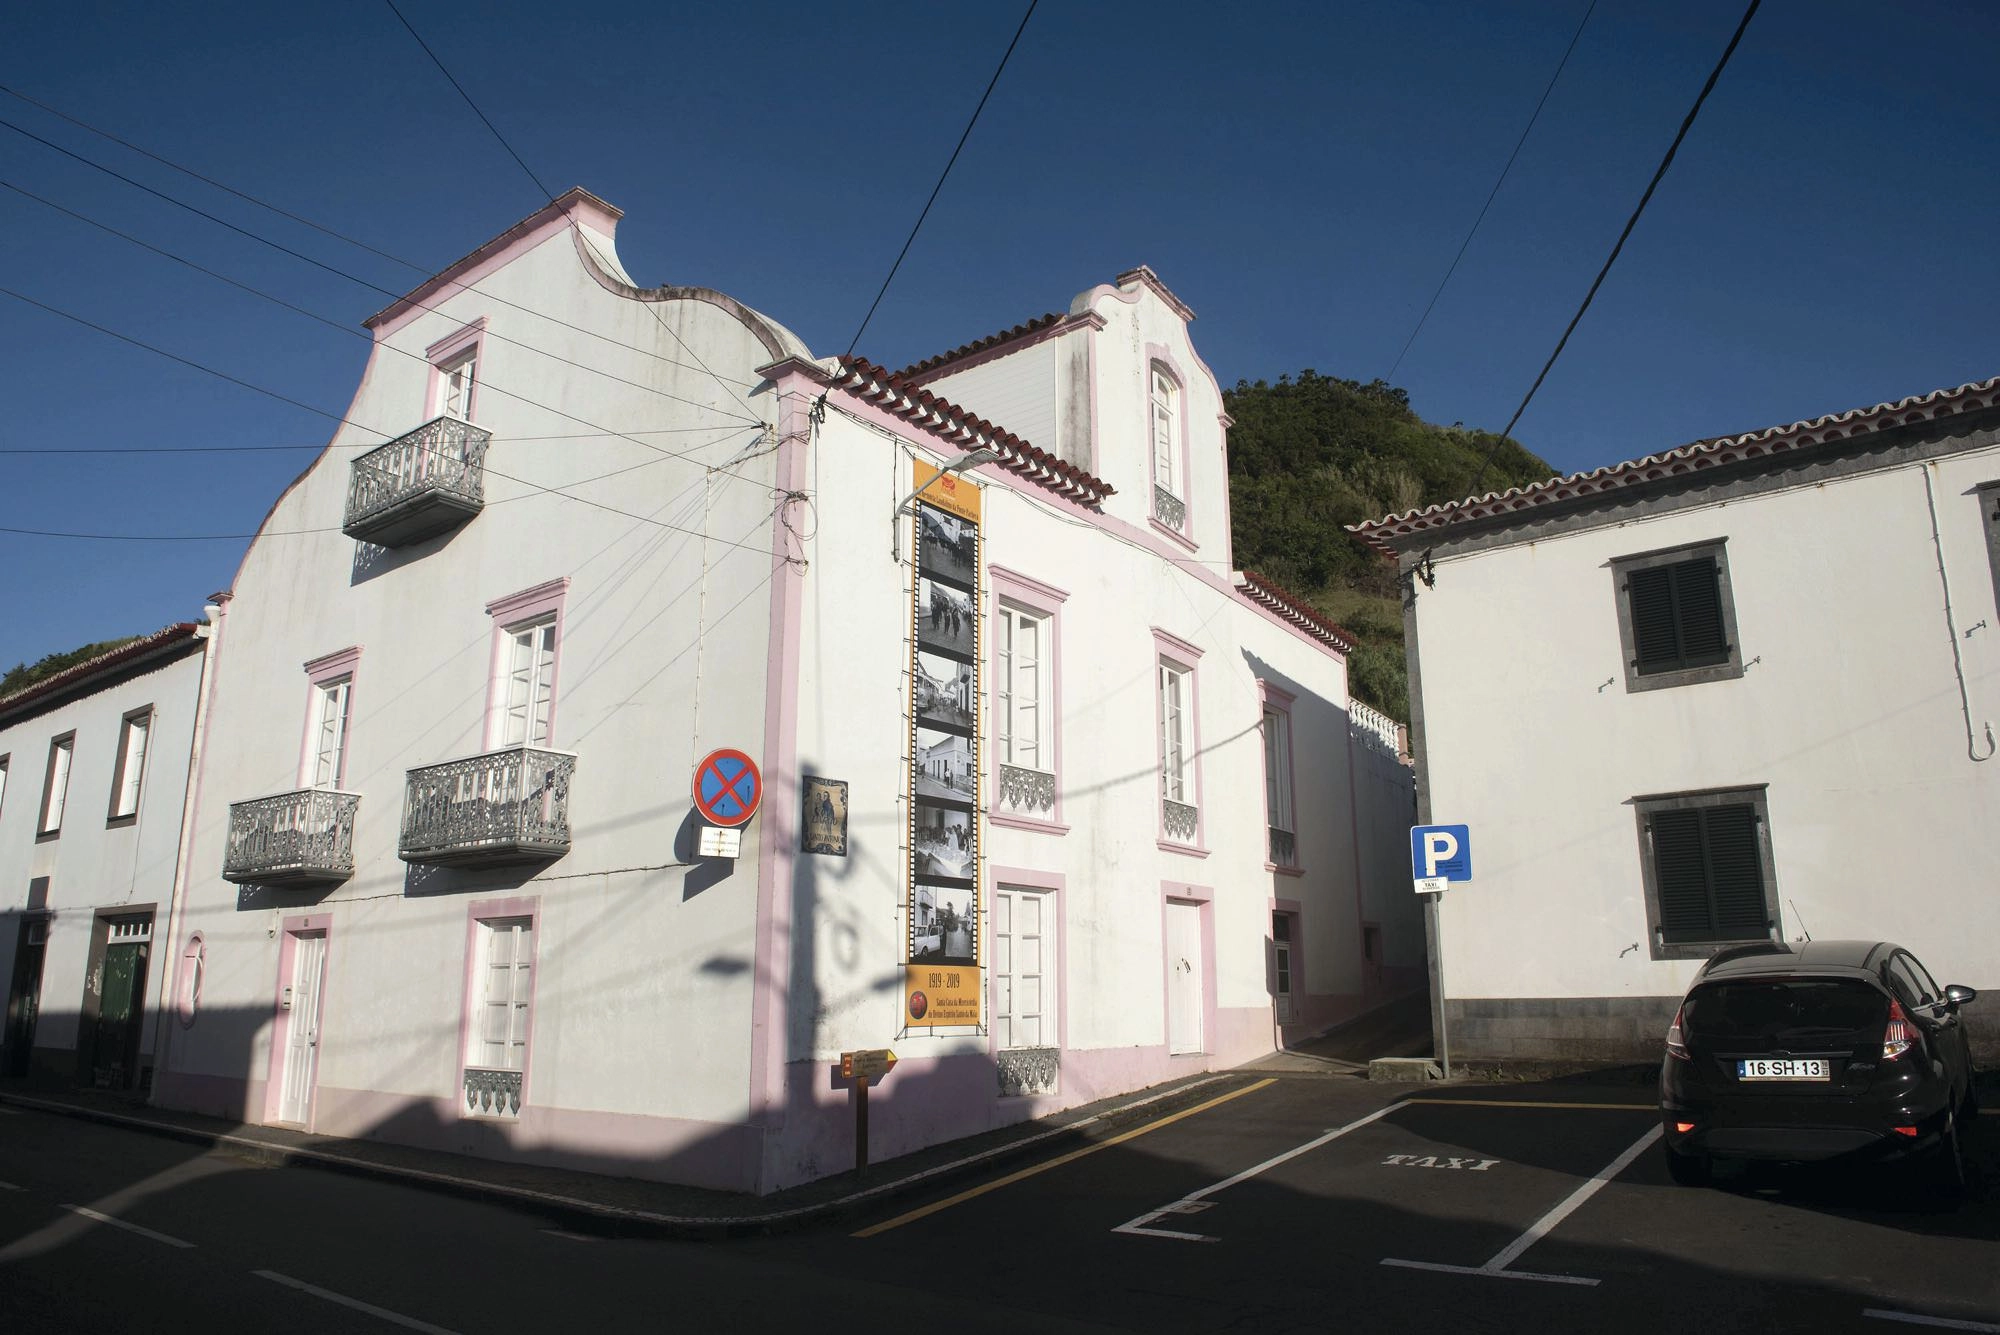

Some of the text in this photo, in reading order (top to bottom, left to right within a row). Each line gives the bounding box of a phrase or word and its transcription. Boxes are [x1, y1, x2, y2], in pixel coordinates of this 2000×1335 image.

[1424, 832, 1458, 877] P
[928, 972, 942, 988] 1919
[946, 973, 960, 988] 2019
[1381, 1154, 1501, 1171] TAXI
